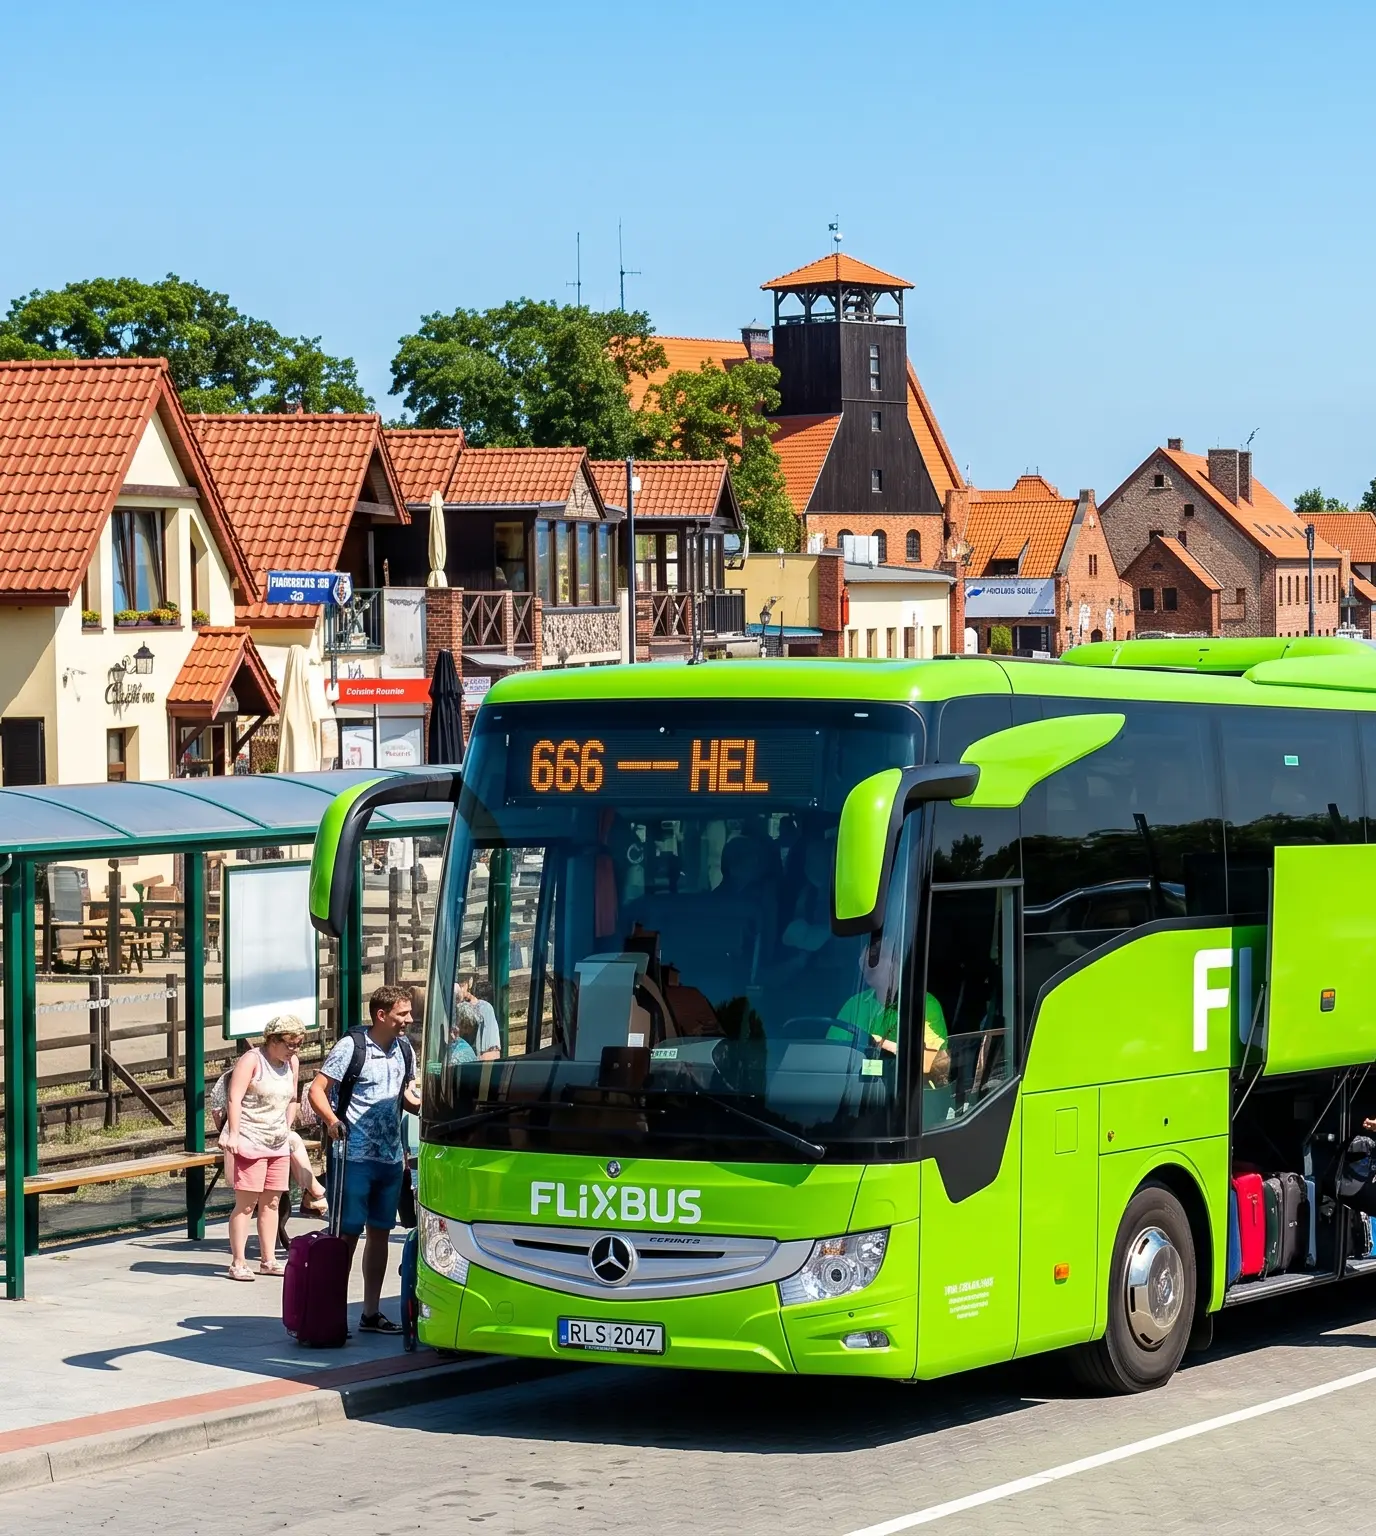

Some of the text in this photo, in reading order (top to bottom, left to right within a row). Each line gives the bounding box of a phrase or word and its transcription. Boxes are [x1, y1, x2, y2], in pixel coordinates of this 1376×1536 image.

[531, 740, 605, 792] 666
[690, 739, 769, 792] HEL
[570, 1323, 656, 1347] RLS 2047
